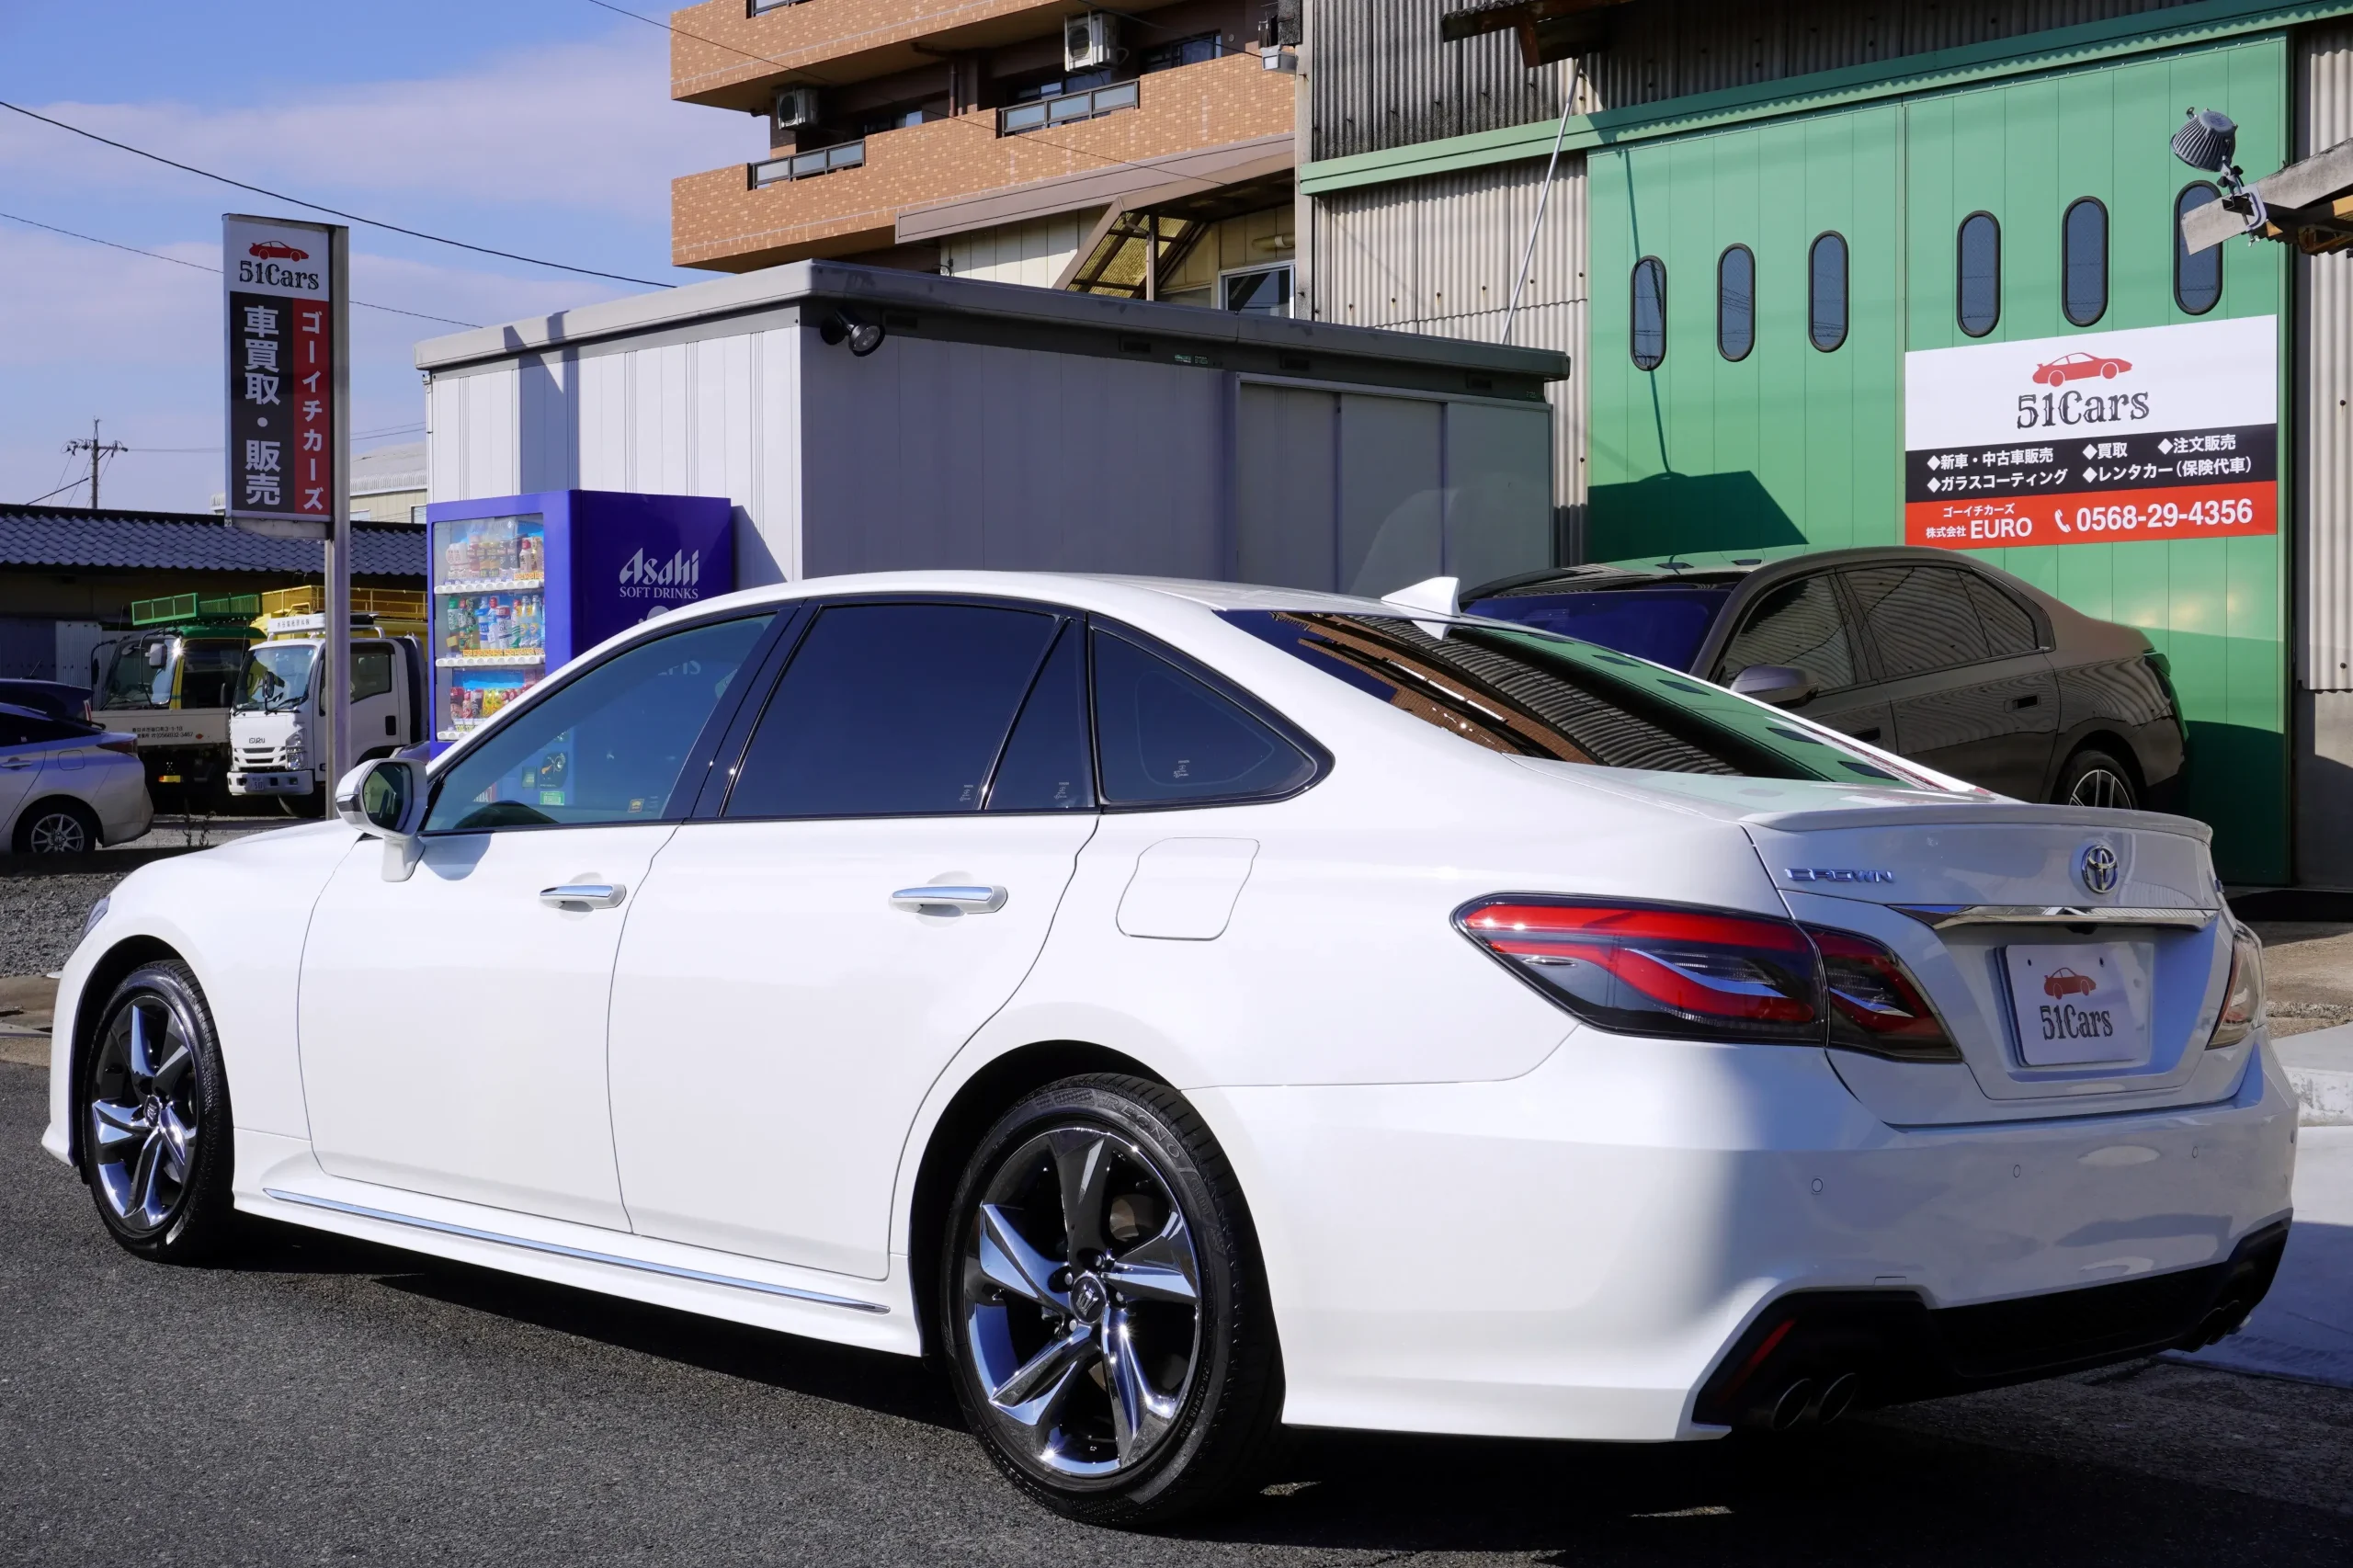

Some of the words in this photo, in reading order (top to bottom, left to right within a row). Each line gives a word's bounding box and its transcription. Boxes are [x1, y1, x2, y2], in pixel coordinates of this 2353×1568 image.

[239, 259, 320, 290] 51Cars
[244, 305, 281, 506] 車買取・販売
[302, 311, 324, 511] ゴーイチカーズ
[2017, 390, 2150, 430] 51Cars
[1940, 447, 2054, 470] 新車・中古車販売
[2097, 442, 2128, 460] 買取
[2173, 434, 2236, 454] 注文販売
[1941, 469, 2068, 492] ガラスコーティング
[1943, 503, 2015, 517] ゴーイチカーズ
[2076, 497, 2253, 532] 0568-29-4356
[1926, 525, 1967, 539] 株式会社
[1971, 517, 2032, 539] EURO
[619, 547, 699, 586] Asahi
[620, 586, 651, 598] SOFT
[654, 587, 699, 599] DRINKS
[1784, 868, 1895, 883] CROWN
[2039, 1004, 2114, 1041] 51Cars
